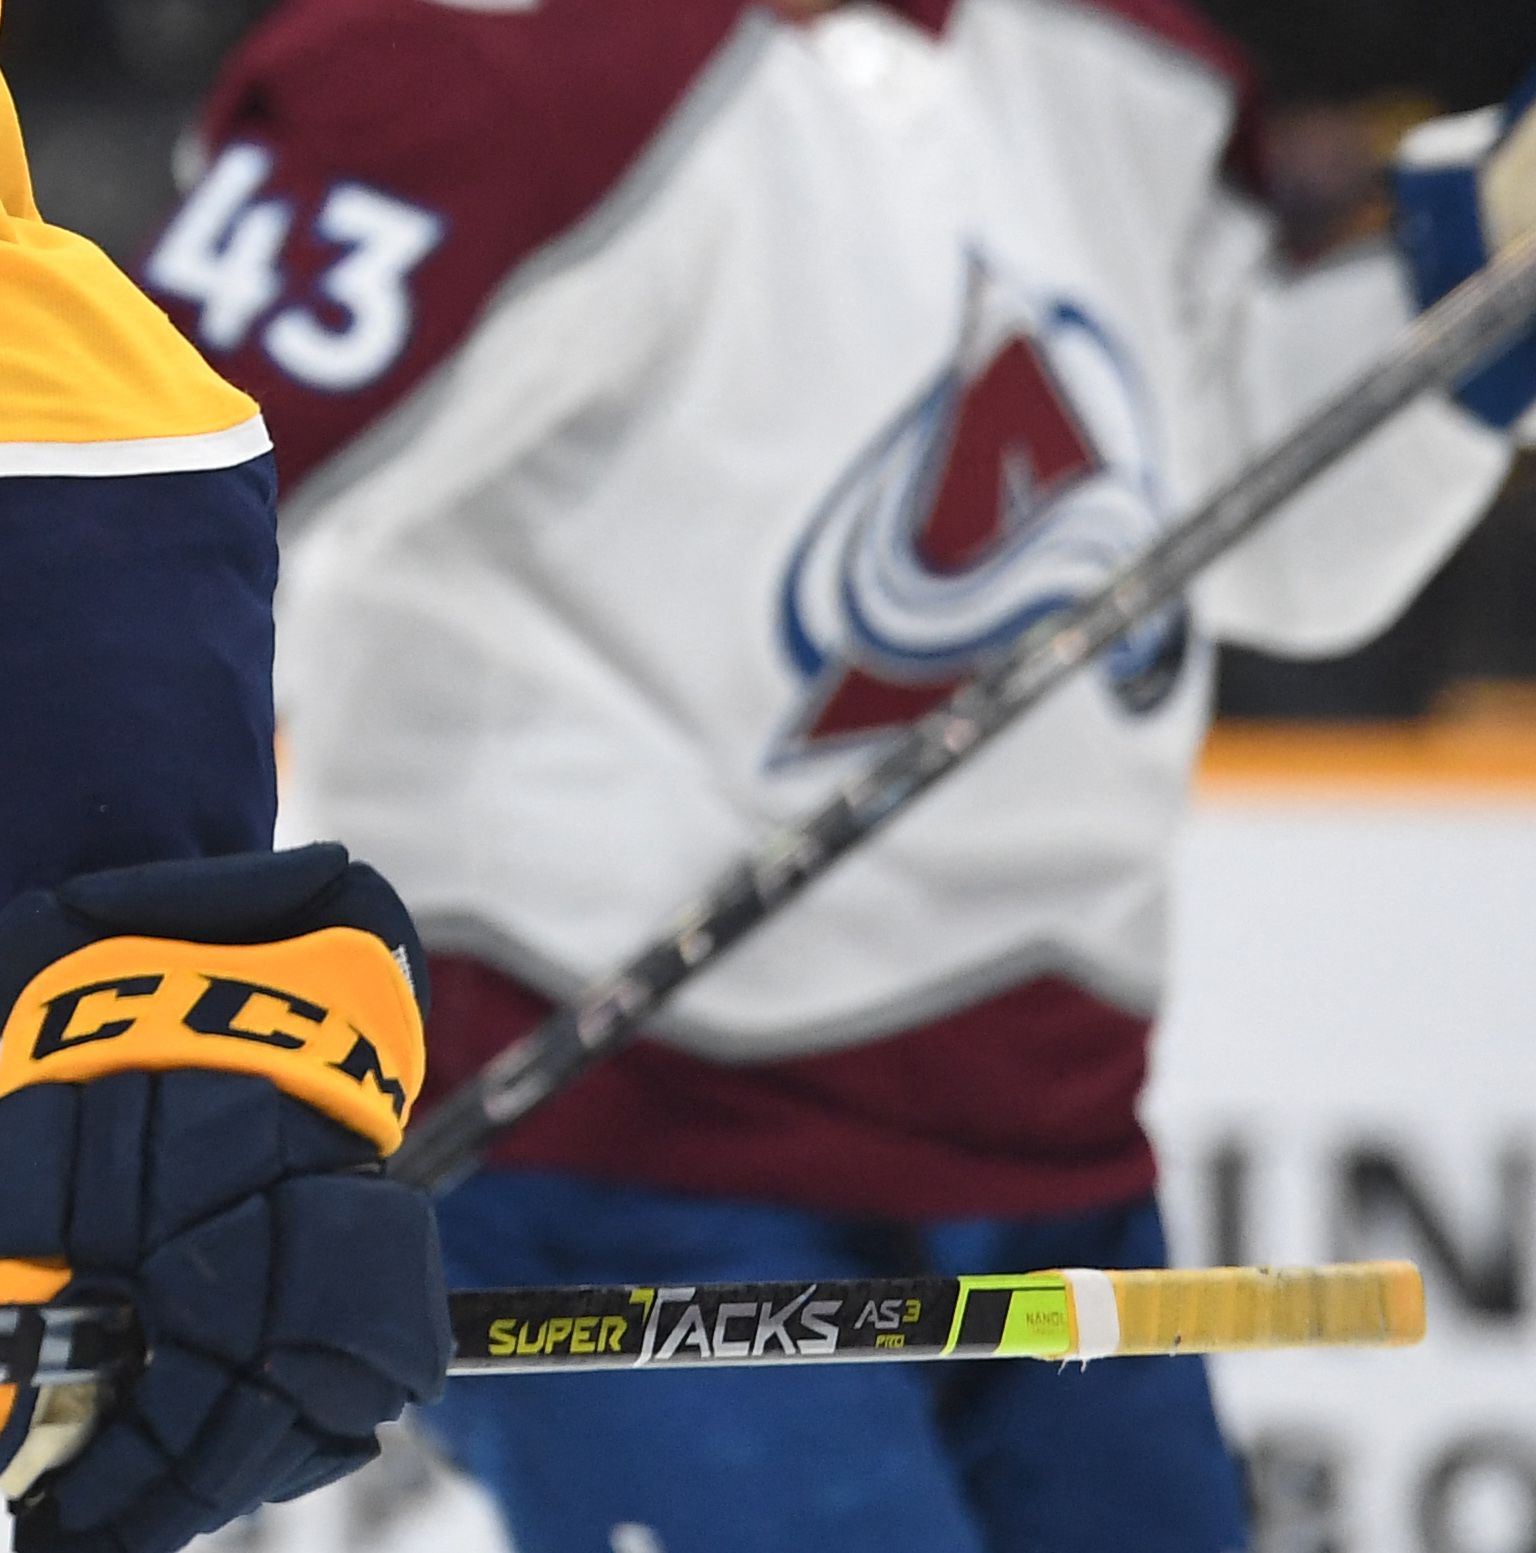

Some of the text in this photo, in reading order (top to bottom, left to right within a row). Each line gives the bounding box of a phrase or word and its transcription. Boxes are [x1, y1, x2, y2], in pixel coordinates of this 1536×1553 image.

[140, 140, 450, 390] 43
[29, 973, 407, 1121] CCM
[488, 1315, 628, 1355] SUPER
[630, 1283, 844, 1367] TACKS
[873, 1333, 906, 1349] PRO
